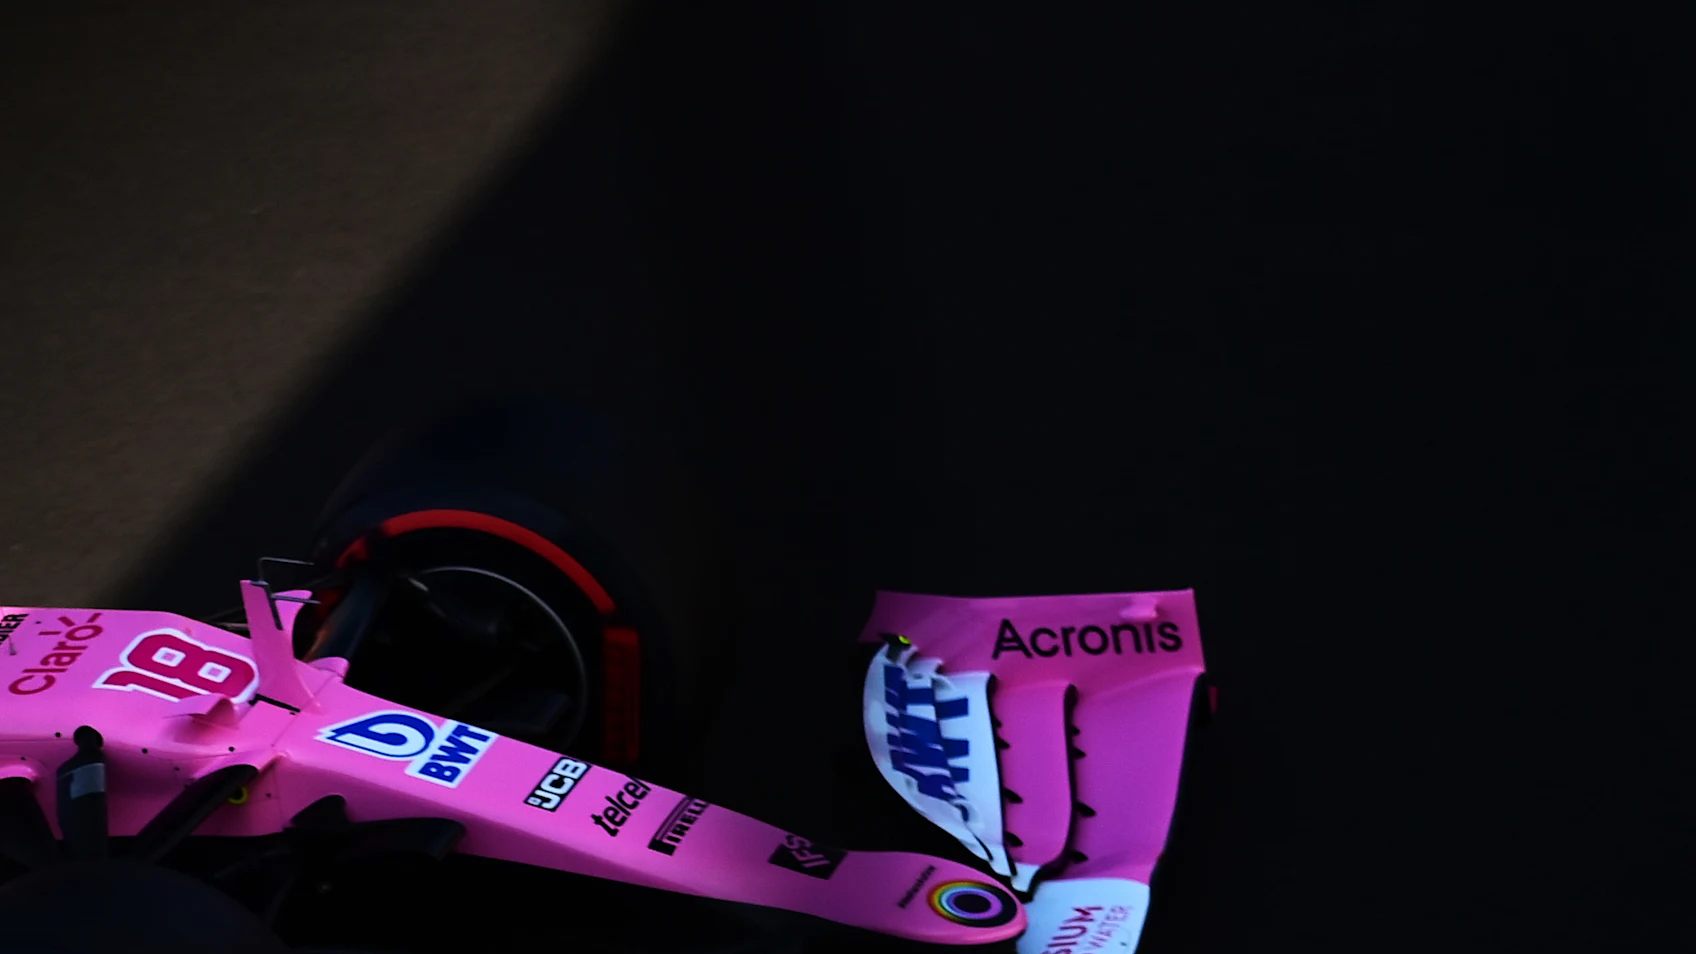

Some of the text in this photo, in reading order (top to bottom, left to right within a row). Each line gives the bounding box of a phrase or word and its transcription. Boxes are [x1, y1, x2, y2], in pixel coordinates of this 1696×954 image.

[9, 622, 102, 696] Claro
[95, 629, 259, 702] 18
[992, 619, 1183, 660] Acronis
[419, 722, 492, 785] BWT
[534, 759, 587, 812] JCB
[592, 777, 651, 836] telcel
[648, 796, 707, 856] PIRELL
[1088, 905, 1132, 949] WATER
